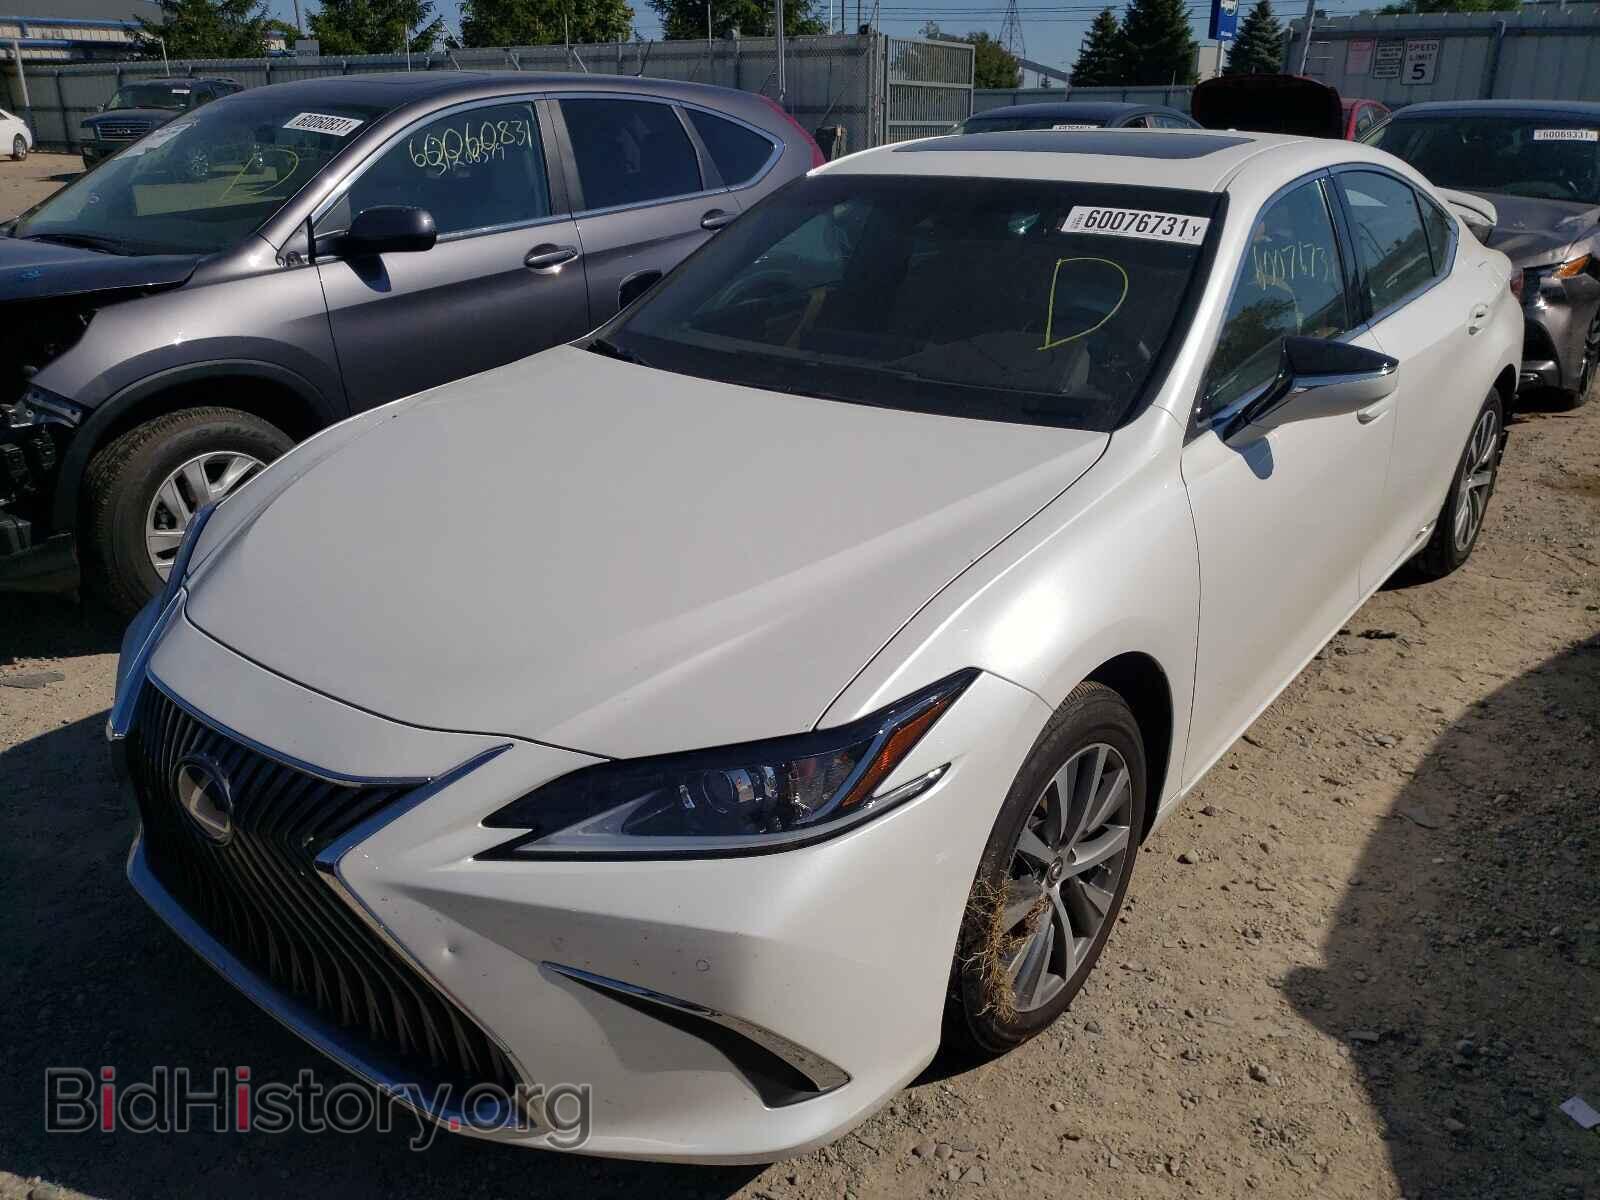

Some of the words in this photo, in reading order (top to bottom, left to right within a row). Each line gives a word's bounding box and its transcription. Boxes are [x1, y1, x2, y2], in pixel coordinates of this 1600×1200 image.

[1408, 43, 1438, 51] SPEED
[1409, 53, 1433, 61] LIMIT
[1411, 63, 1426, 80] 5
[296, 114, 351, 132] 60060831
[1084, 209, 1190, 238] 60076731
[1192, 225, 1201, 237] Y
